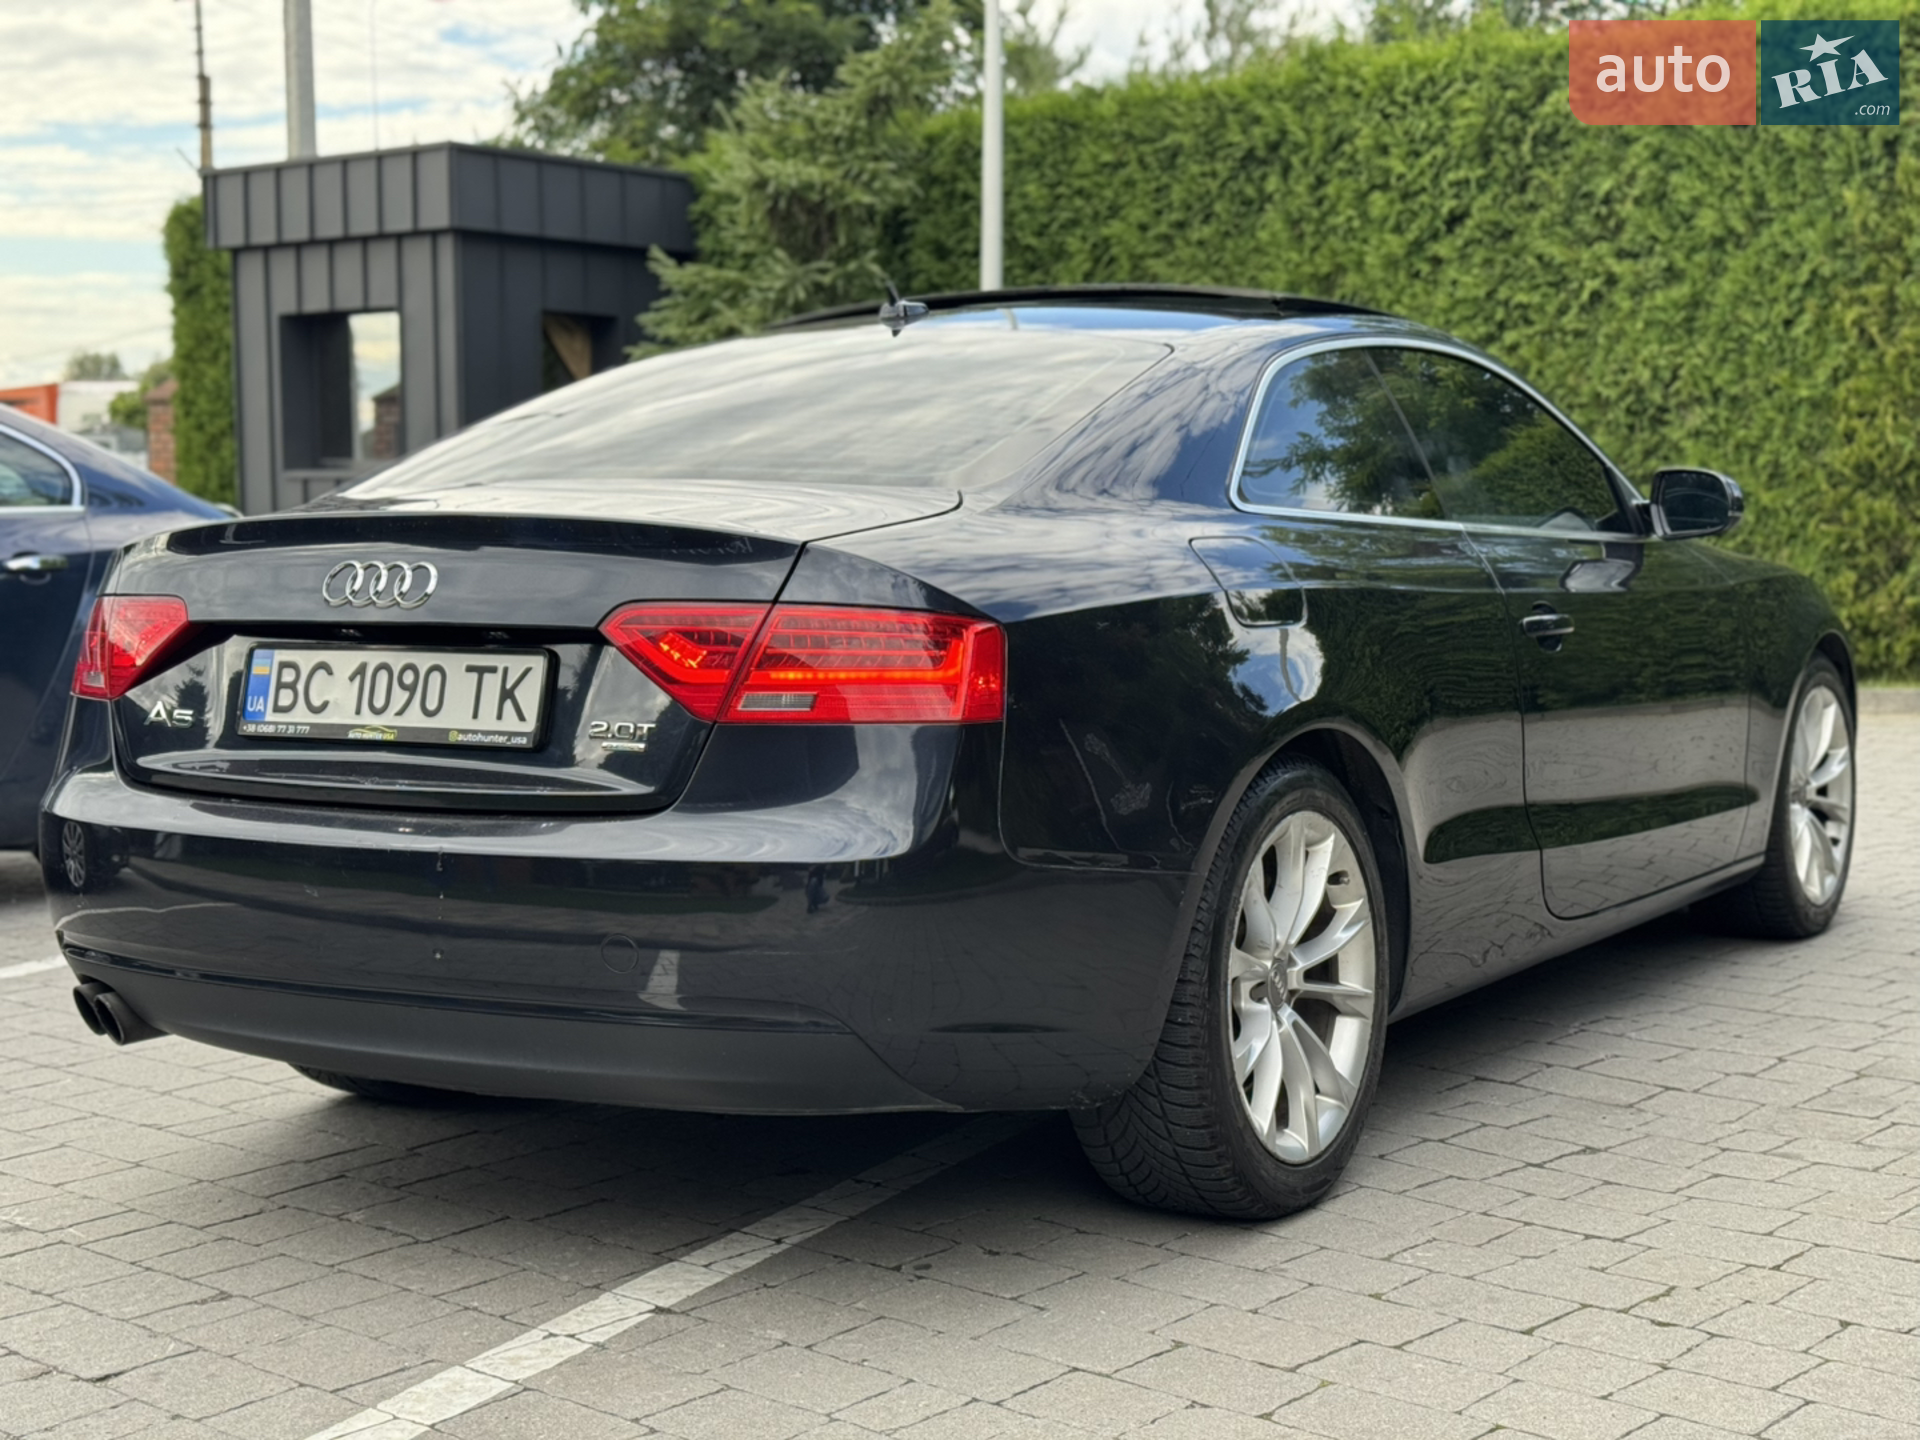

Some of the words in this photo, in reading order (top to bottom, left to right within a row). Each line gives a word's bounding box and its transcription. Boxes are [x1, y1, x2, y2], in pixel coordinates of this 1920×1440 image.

[272, 660, 334, 715] BC
[347, 661, 448, 718] 1090
[465, 664, 534, 722] TK
[143, 700, 194, 728] A5
[247, 695, 265, 714] UA
[588, 720, 657, 740] 2.0T
